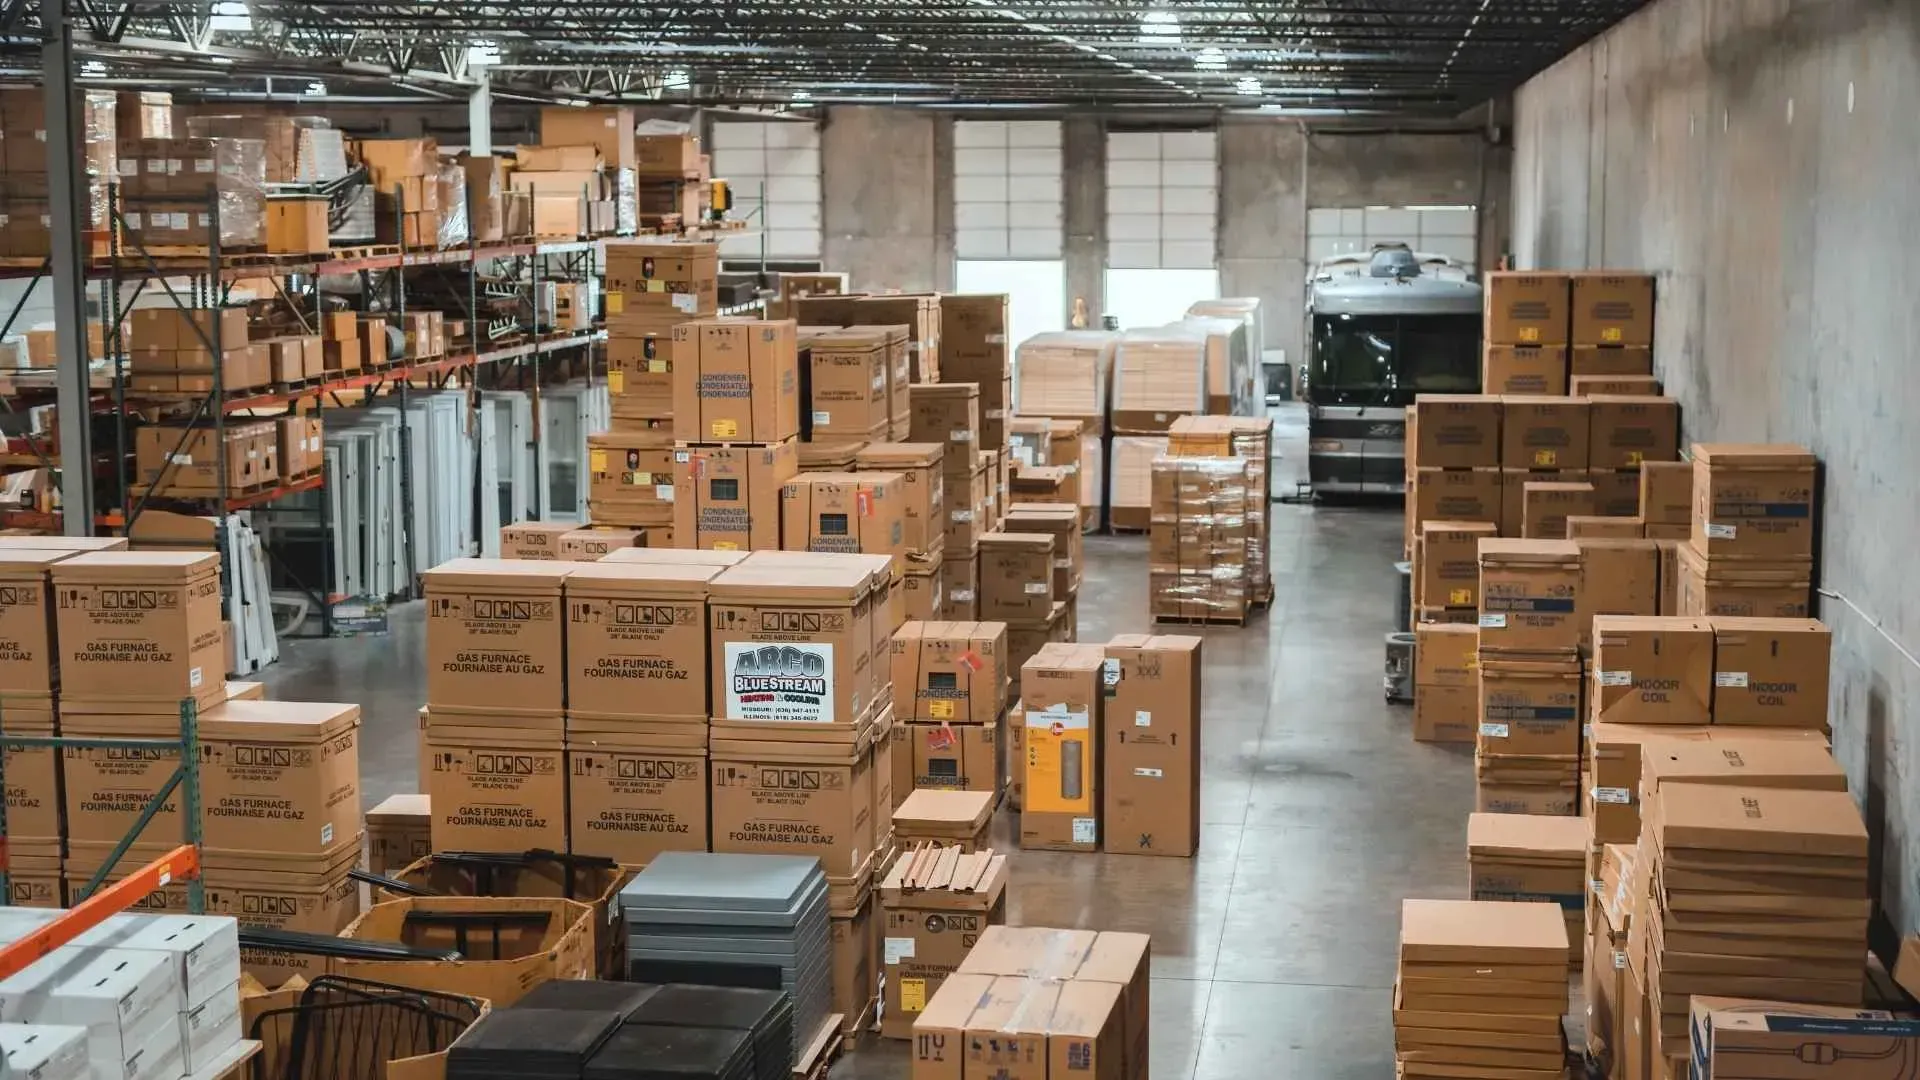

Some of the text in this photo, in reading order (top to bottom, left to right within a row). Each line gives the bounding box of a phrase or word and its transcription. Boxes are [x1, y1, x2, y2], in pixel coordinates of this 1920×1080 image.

[87, 643, 159, 653] GAS FURNACE
[12, 652, 32, 661] GAZ
[74, 652, 173, 662] FOURNAISE AU GAZ
[456, 653, 532, 664] GAS FURNACE
[735, 646, 825, 677] ARCO
[443, 663, 544, 674] FOURNAISE AU GAZ
[598, 659, 674, 669] GAS FURNACE
[584, 668, 688, 680] FOURNAISE AU GAZ
[1631, 679, 1680, 690] INDOOR
[1748, 681, 1798, 693] INDOOR
[916, 689, 970, 698] CONDENSER
[1641, 692, 1671, 703] COIL
[1757, 694, 1786, 706] COIL
[916, 775, 971, 786] CONDENSER
[93, 793, 154, 802] GAS FURNAC
[20, 800, 41, 808] GAZ
[81, 803, 137, 813] FOURNAISE
[220, 798, 292, 810] GAS FURNACE
[208, 807, 305, 820] FOURNAISE AU GAZ
[459, 807, 533, 818] GAS FURNACE
[600, 811, 676, 823] GAS FURNACE
[447, 816, 547, 828] FOURNAISE AU GAZ
[587, 821, 689, 833] FOURNAISE AU GAZ
[744, 822, 820, 834] GAS FURNACE
[729, 832, 834, 845] FOURNAISE AU GAZ
